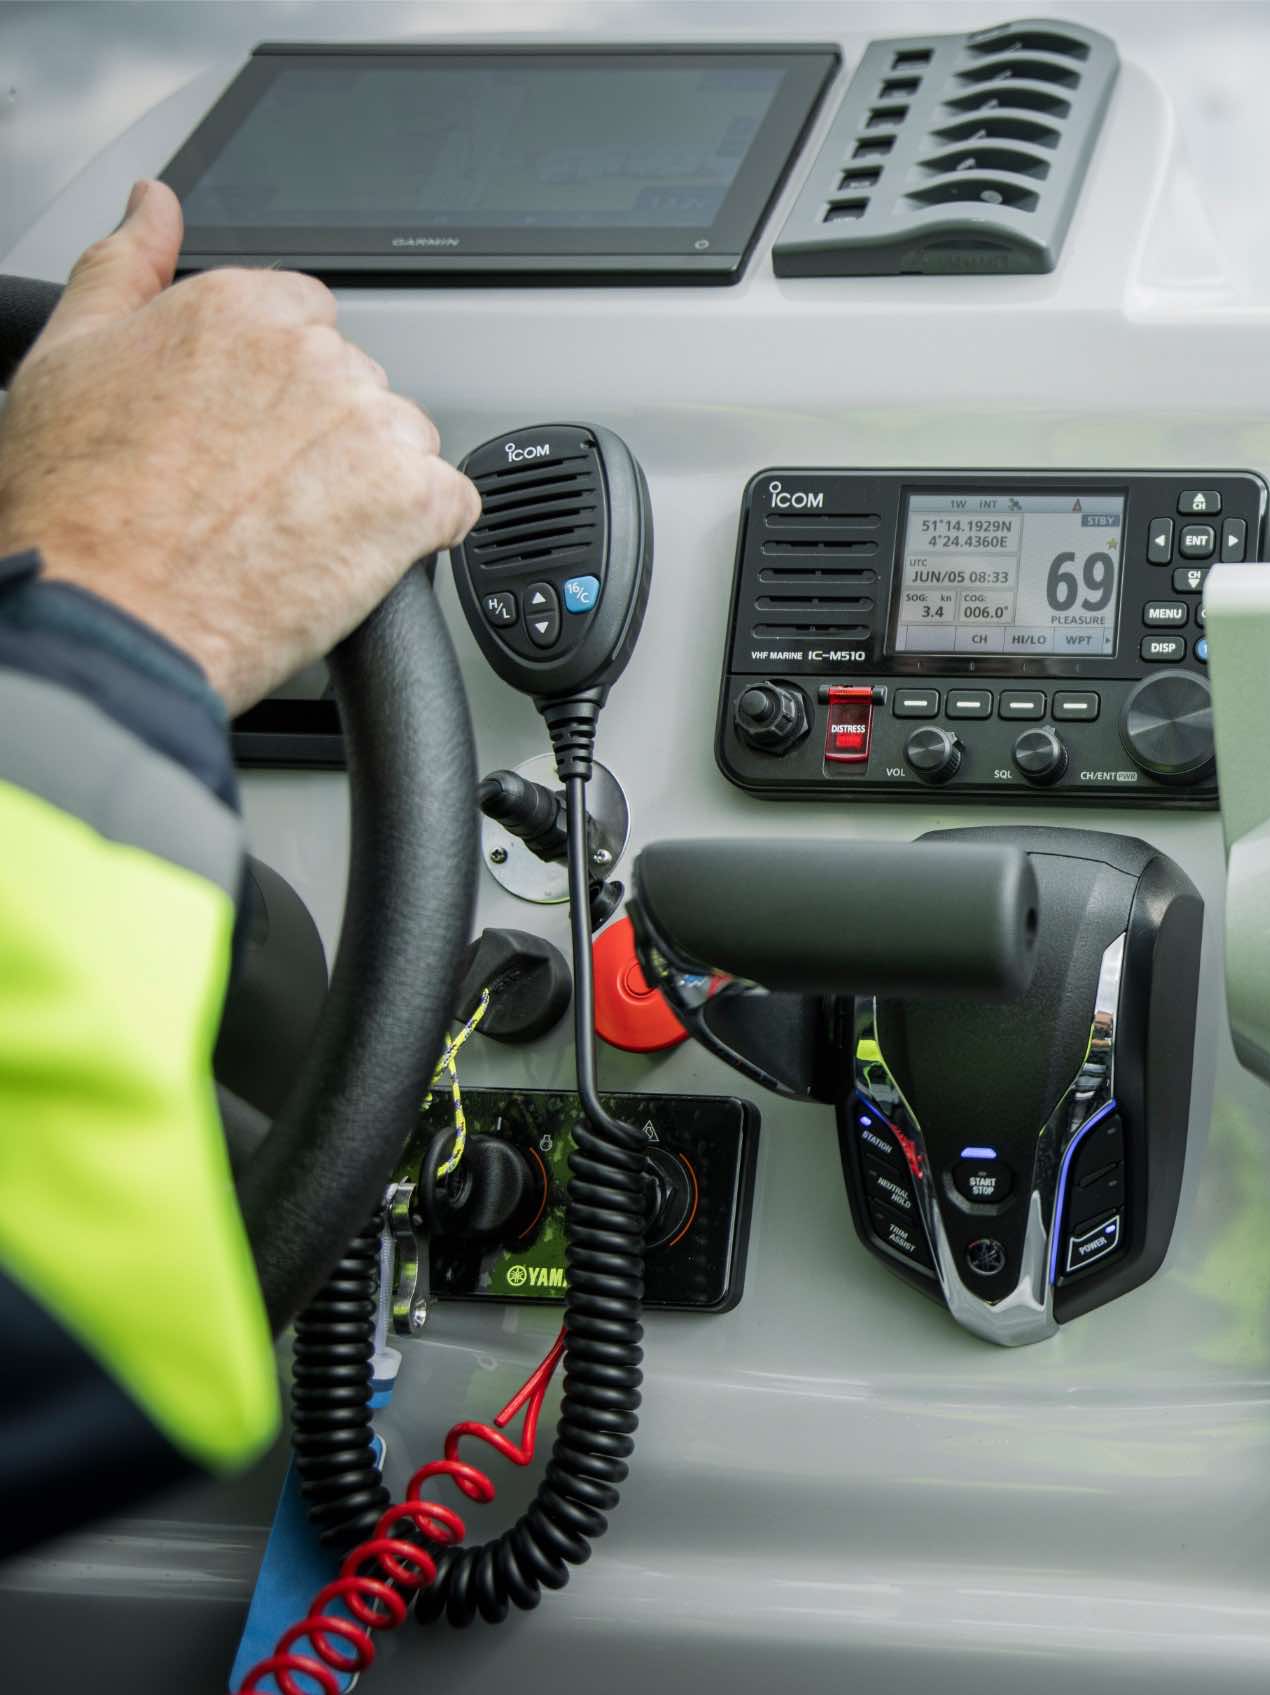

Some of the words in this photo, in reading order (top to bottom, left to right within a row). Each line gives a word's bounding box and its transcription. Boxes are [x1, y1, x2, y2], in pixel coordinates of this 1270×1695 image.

[391, 237, 460, 247] GARMIN
[951, 500, 966, 509] 1W
[1185, 535, 1208, 546] ENT
[909, 558, 928, 567] UTC
[912, 571, 965, 584] JUN/05
[969, 571, 1009, 583] 08:33
[1188, 571, 1201, 579] CH
[1046, 552, 1115, 612] 69
[567, 583, 589, 604] 16/C
[488, 599, 510, 619] H/L
[922, 606, 944, 618] 3.4
[1149, 608, 1182, 618] MENU
[1051, 616, 1105, 625] PLEASURE
[971, 634, 988, 644] CH
[1012, 634, 1046, 645] HI/LO
[1066, 635, 1092, 645] WPT
[1151, 643, 1176, 653] DISP
[751, 651, 769, 660] VHF
[769, 651, 803, 661] MARINE
[808, 650, 866, 661] IC-M510
[831, 725, 866, 734] DISTRESS
[886, 768, 905, 777] VOL
[994, 769, 1012, 779] SQL
[862, 1130, 893, 1153] STATION
[969, 1177, 997, 1186] START
[877, 1177, 909, 1199] NEUTRAL
[972, 1186, 995, 1195] STOP
[891, 1194, 911, 1209] HOLD
[889, 1224, 909, 1240] TRIM
[888, 1234, 916, 1253] ASSIST
[1079, 1236, 1108, 1255] POWER
